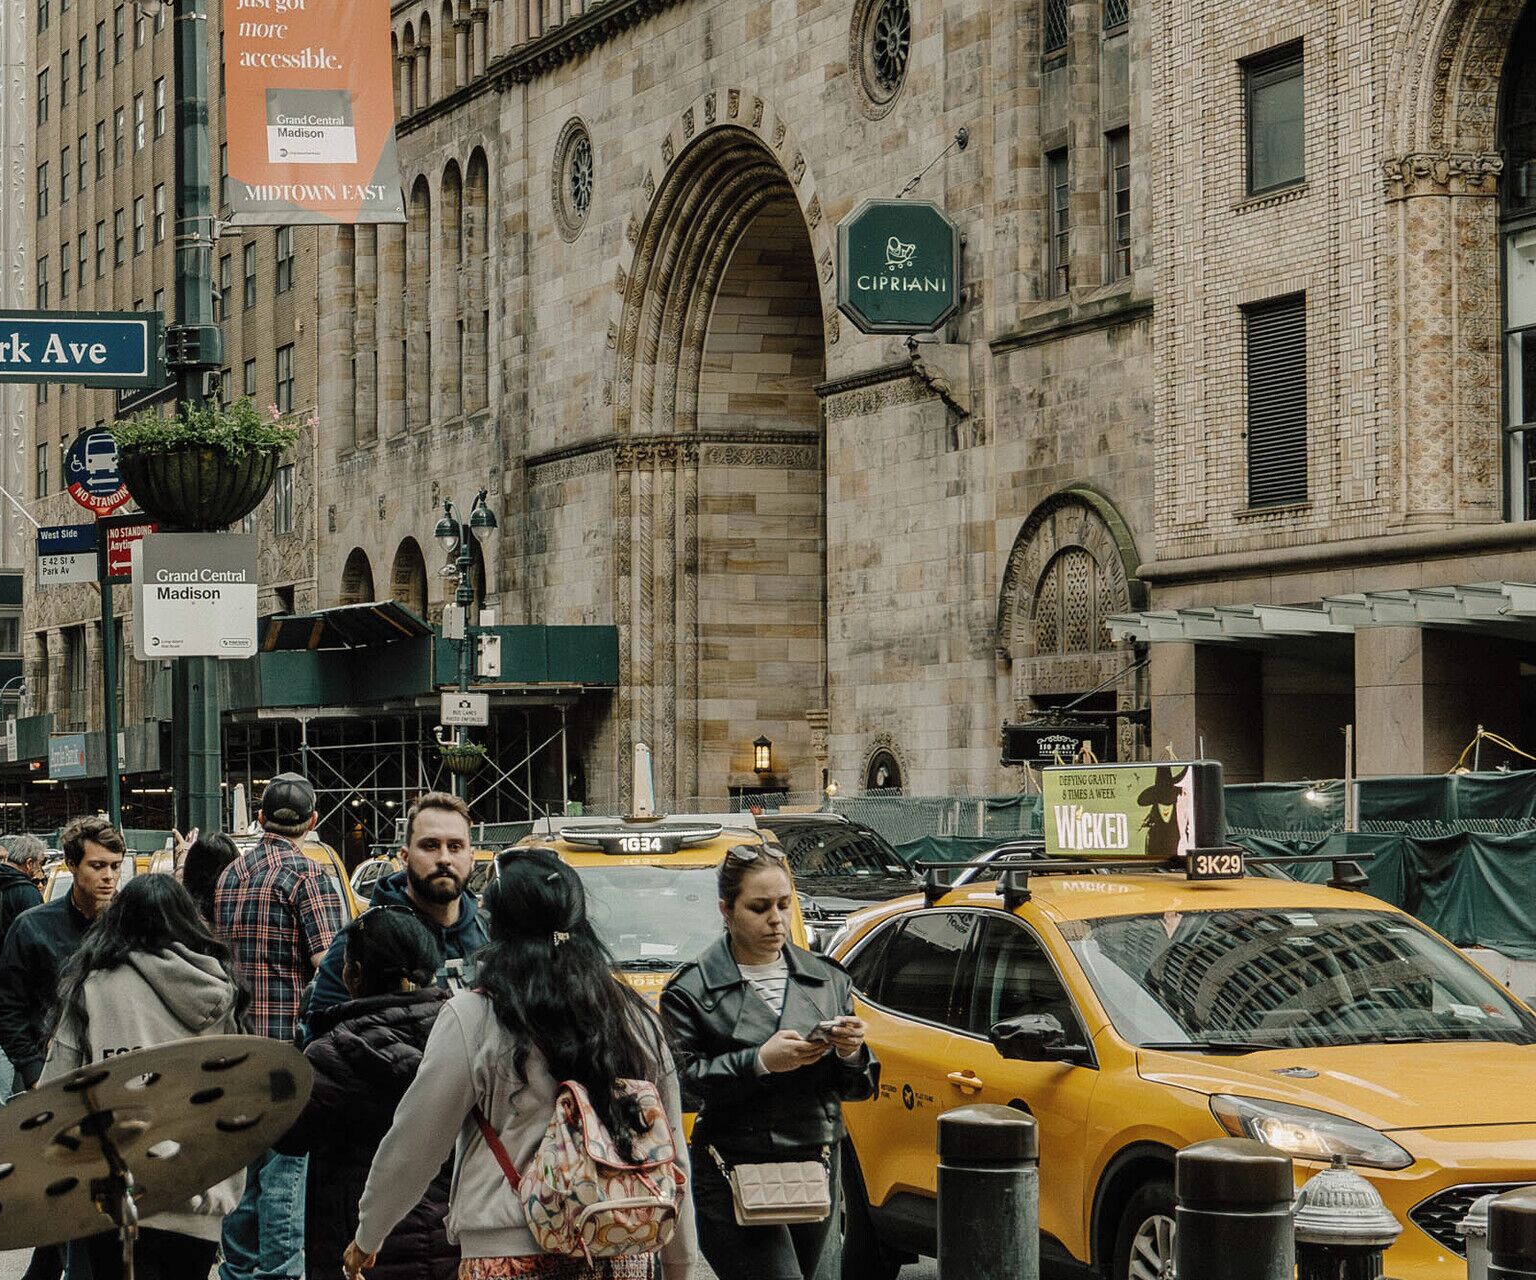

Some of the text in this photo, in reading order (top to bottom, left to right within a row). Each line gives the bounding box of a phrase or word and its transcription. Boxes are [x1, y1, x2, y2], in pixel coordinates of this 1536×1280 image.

[239, 21, 288, 39] more
[239, 47, 343, 70] accessible.
[276, 114, 345, 126] Grand Central
[277, 128, 324, 139] Madison
[244, 184, 386, 201] MIDTOWN EAST
[857, 275, 946, 292] CIPRIANI
[41, 333, 107, 364] Ave
[75, 486, 130, 507] NO STANDIN
[40, 529, 78, 539] West Side
[109, 525, 152, 538] NO STANDING
[42, 556, 75, 566] E 42 St &
[42, 566, 70, 576] Park Av
[156, 568, 246, 583] Grand Central
[157, 586, 221, 600] Madison
[1059, 774, 1117, 786] DEFYING GRAVITY
[1068, 789, 1088, 800] TIMES
[1089, 789, 1094, 799] A
[1096, 788, 1116, 799] WEEK
[618, 837, 662, 852] 1G34
[1196, 855, 1241, 874] 3K29
